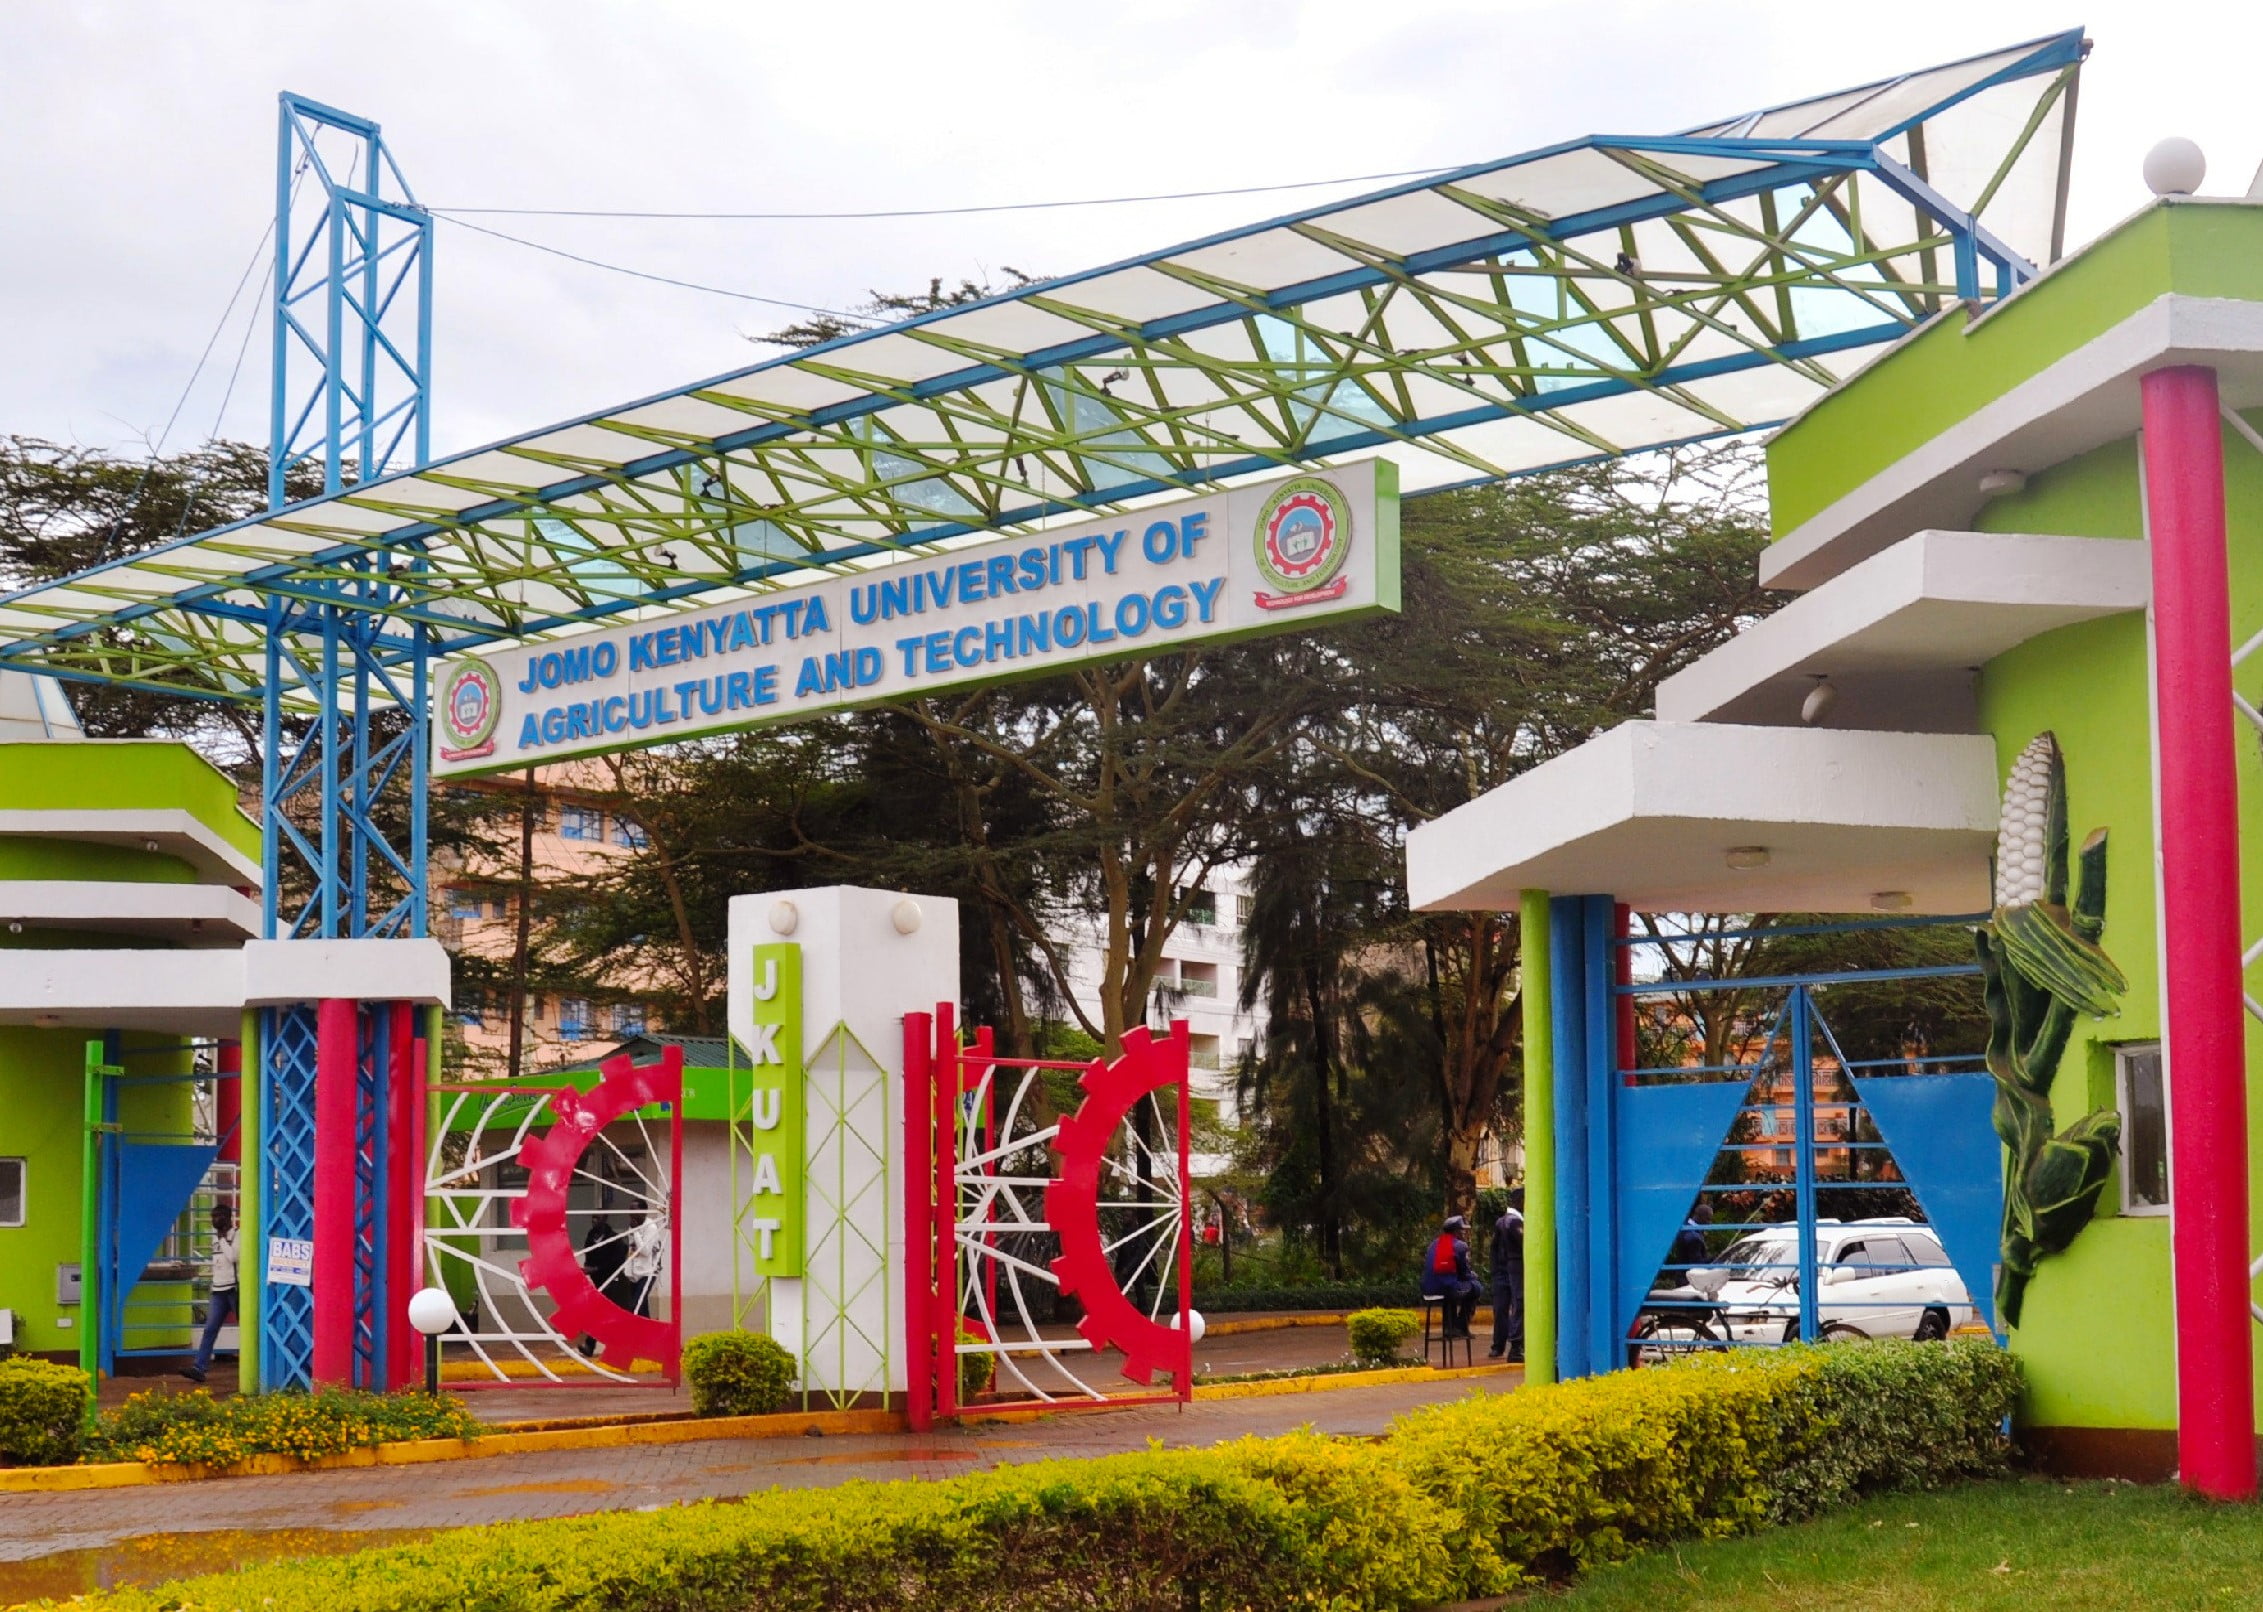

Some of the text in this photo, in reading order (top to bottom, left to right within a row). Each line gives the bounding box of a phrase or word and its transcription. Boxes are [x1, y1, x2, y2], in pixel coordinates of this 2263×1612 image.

[517, 664, 779, 750] AGRICULTURE
[794, 646, 883, 698] AND
[896, 576, 1226, 678] TECHNOLOGY
[518, 641, 619, 694] JOMO
[628, 595, 831, 672] KENYATTA
[849, 529, 1129, 626] UNIVERSITY
[1142, 511, 1211, 566] OF
[752, 959, 783, 1260] JKUAT
[271, 1240, 312, 1262] BABS
